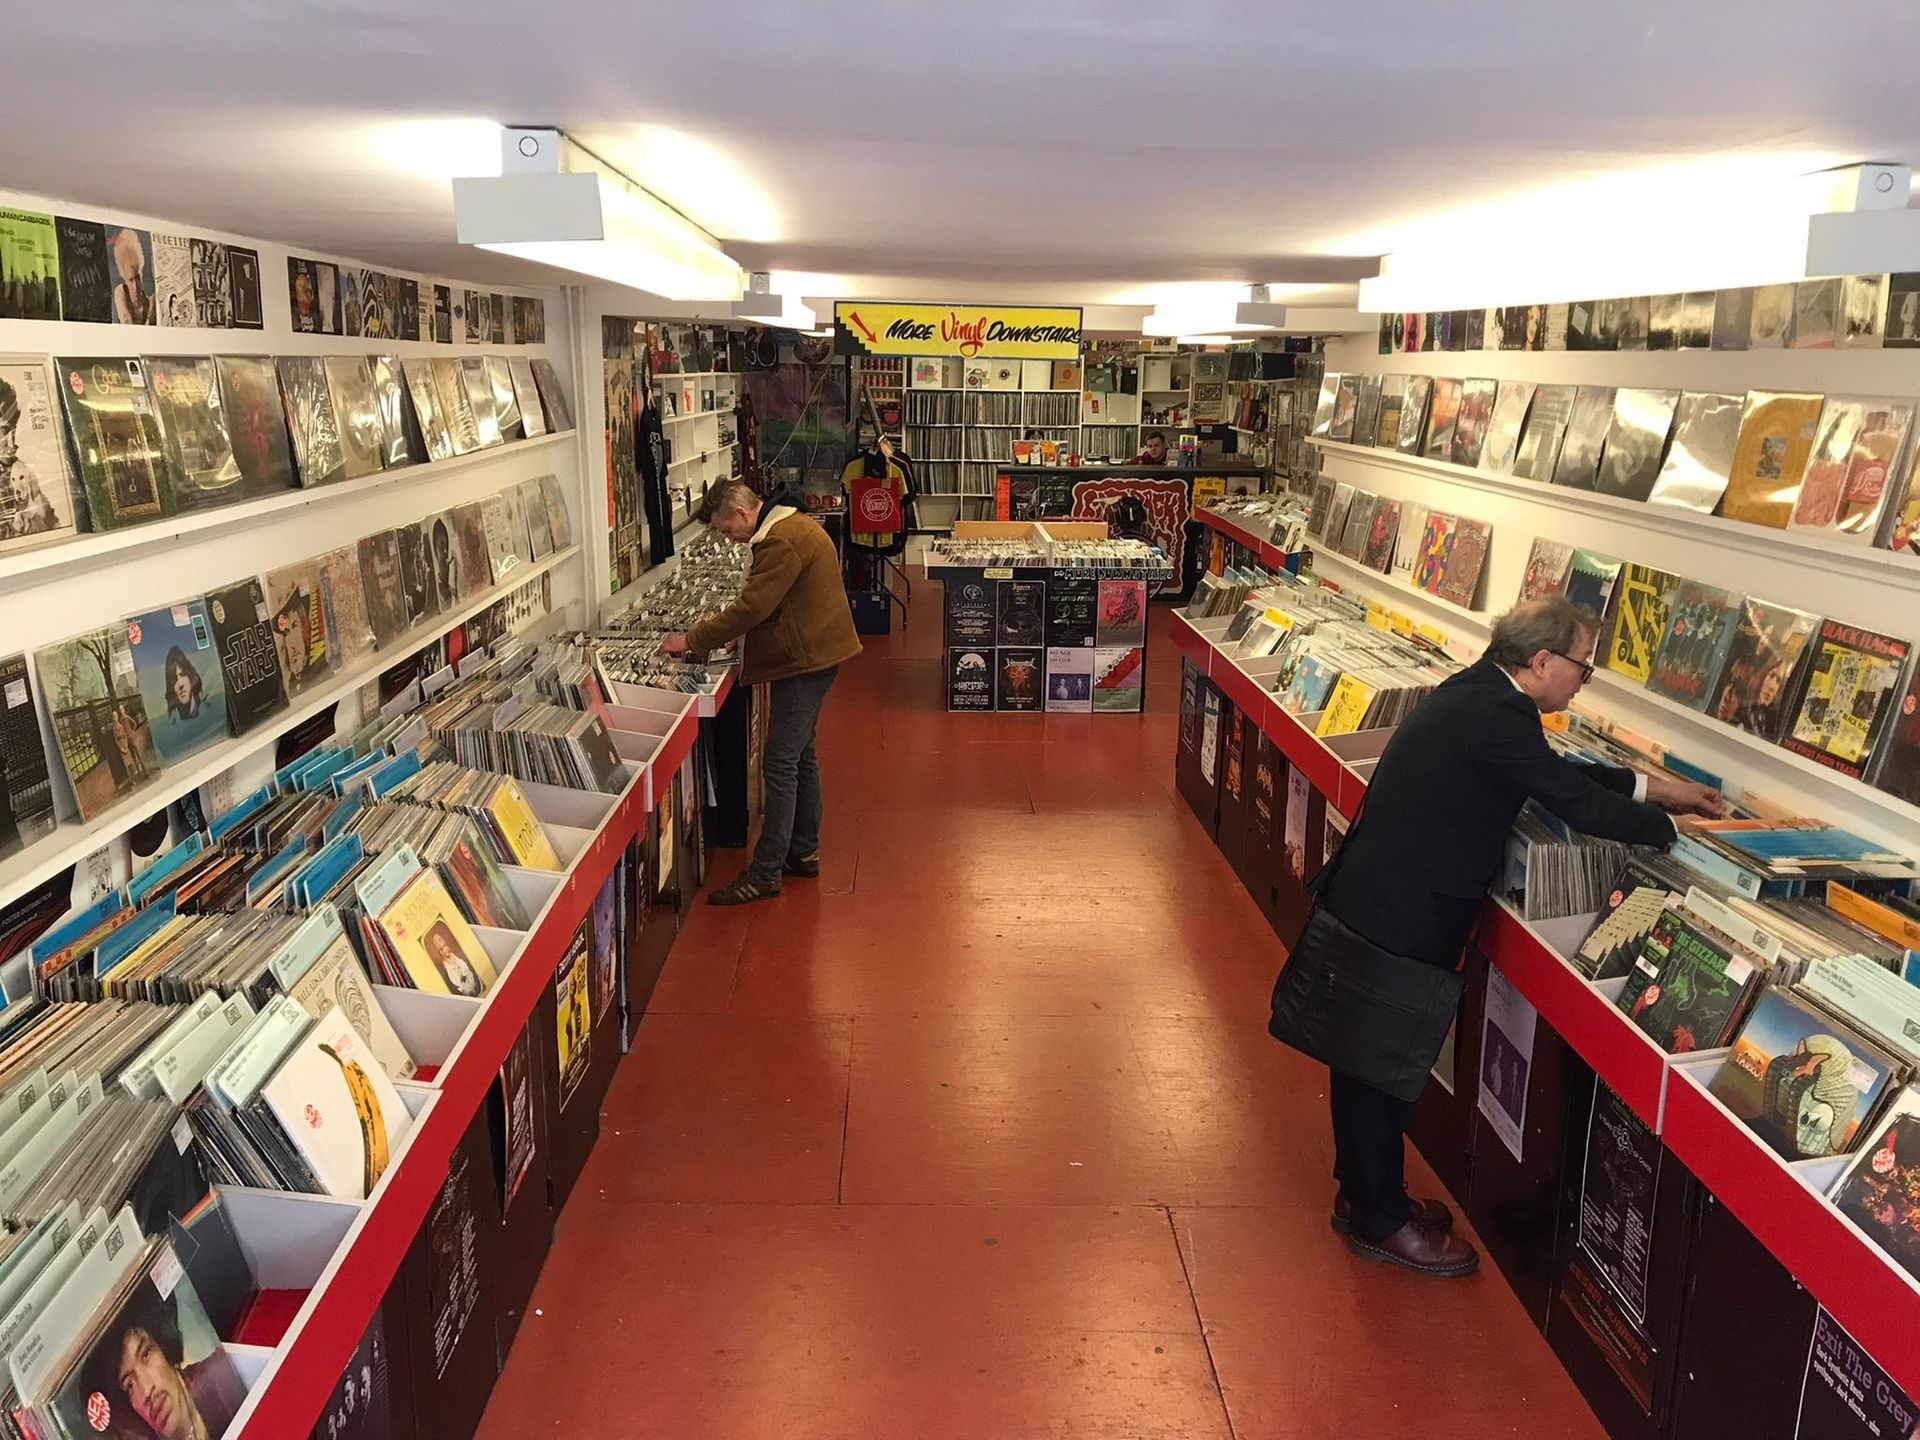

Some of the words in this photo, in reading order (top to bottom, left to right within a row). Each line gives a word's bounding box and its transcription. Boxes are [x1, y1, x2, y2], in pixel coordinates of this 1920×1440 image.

[885, 318, 935, 340] MORE
[941, 311, 986, 357] Vinyl
[986, 320, 1081, 344] DOWNSTAIRS
[223, 622, 274, 667] STAR
[1823, 622, 1861, 646] BLACK
[1860, 632, 1891, 655] FLAG
[226, 647, 277, 693] WARS
[1688, 940, 1729, 973] GIZZAR
[1735, 1053, 1765, 1082] TARKUS
[1817, 1316, 1842, 1359] Exit
[1845, 1346, 1872, 1389] The
[1876, 1381, 1913, 1434] Grey
